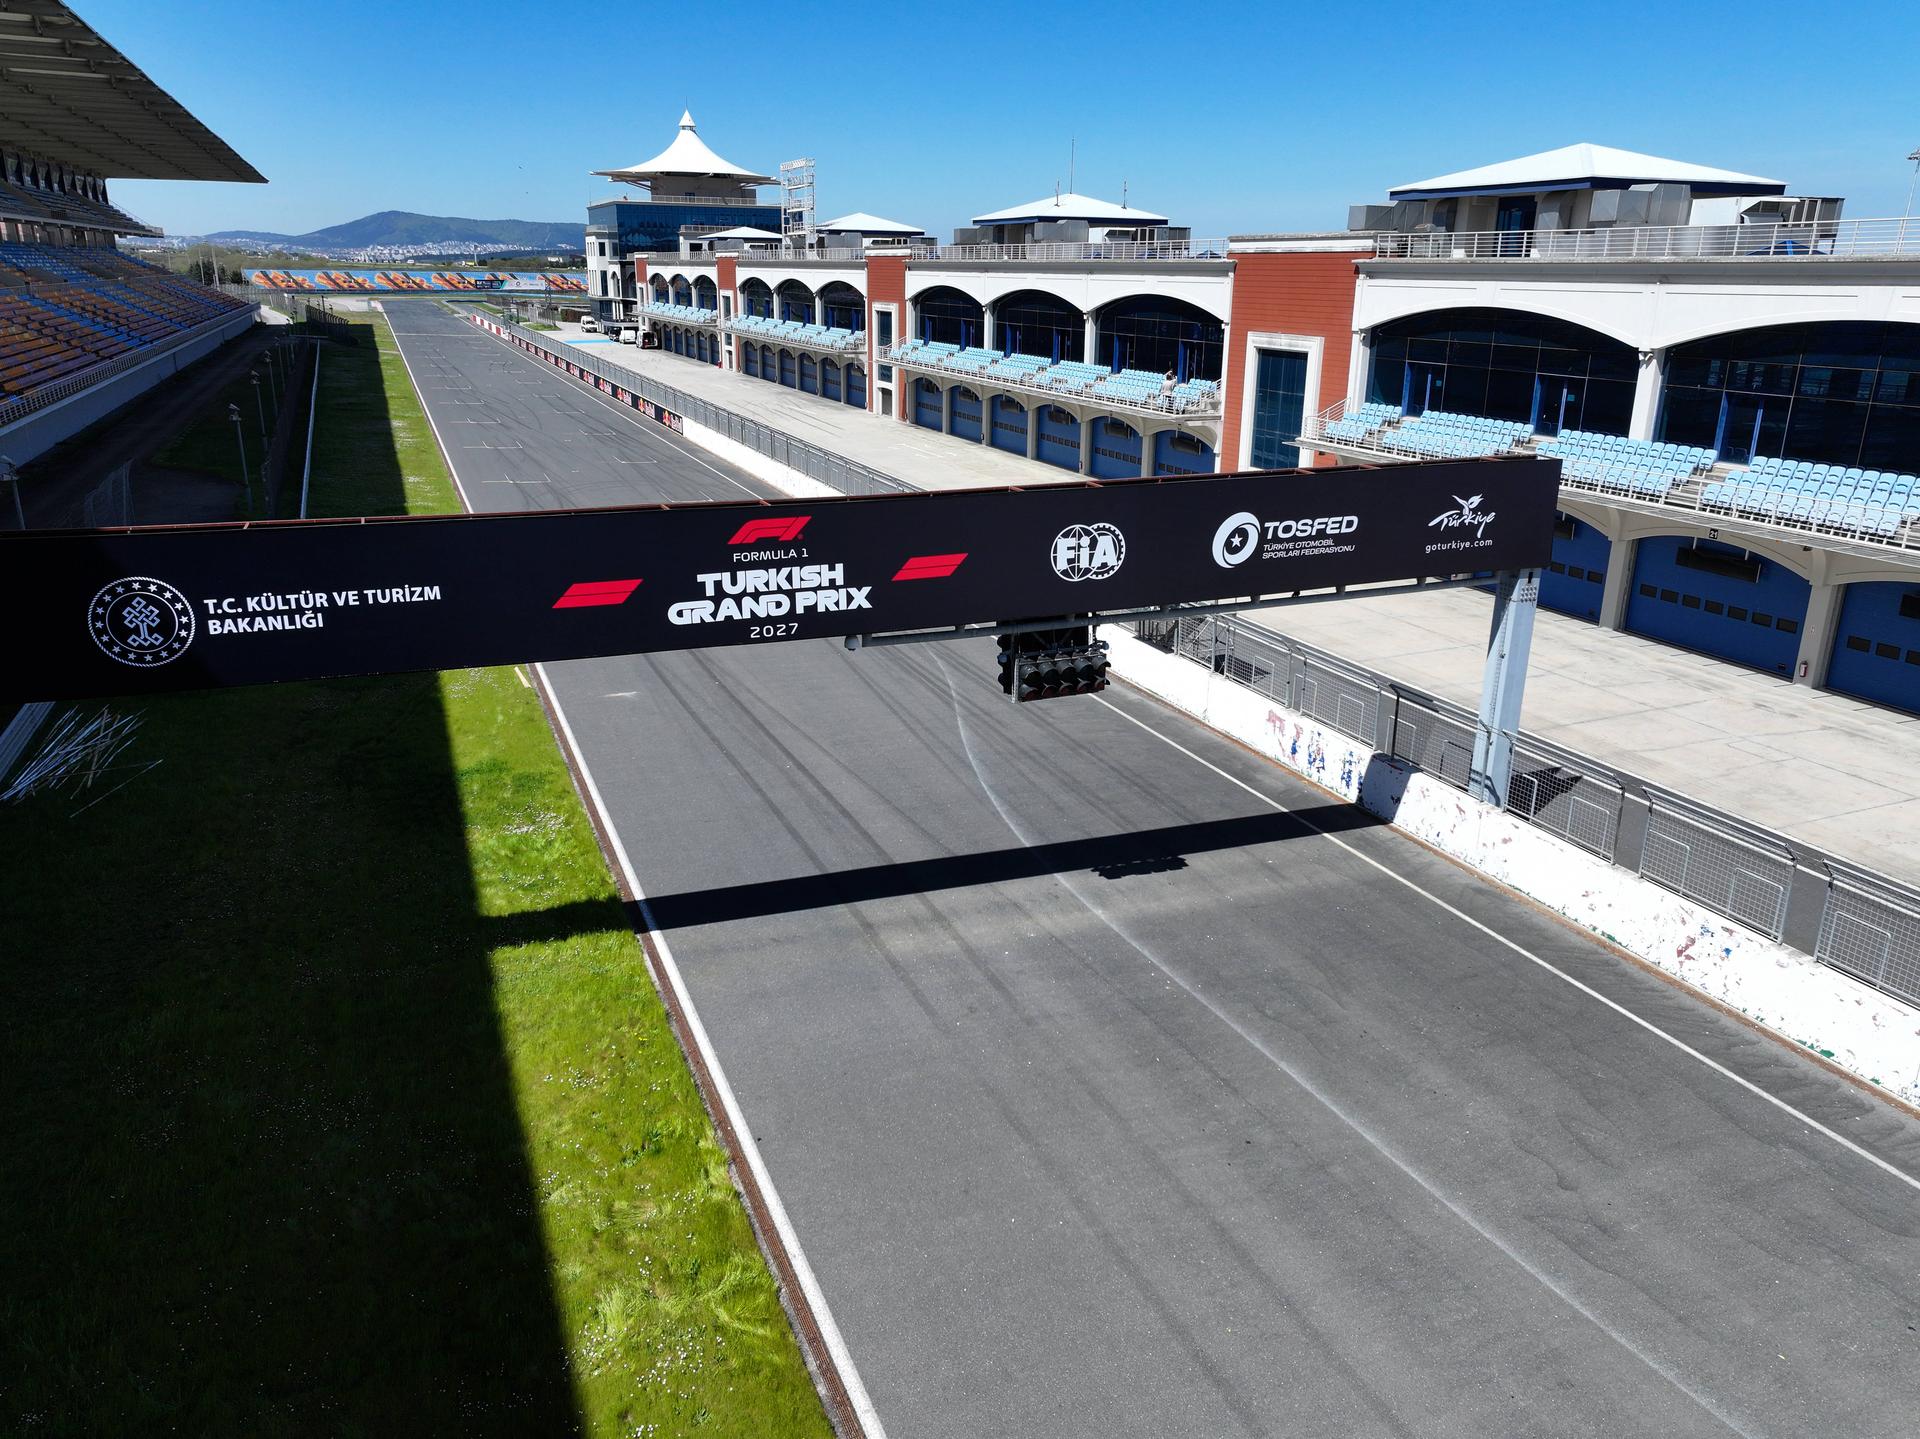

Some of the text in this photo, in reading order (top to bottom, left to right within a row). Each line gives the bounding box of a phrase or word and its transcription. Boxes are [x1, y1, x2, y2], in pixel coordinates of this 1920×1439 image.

[1265, 516, 1358, 539] TOSFED
[734, 548, 809, 562] FORMULA 1
[1262, 545, 1356, 560] SPORLARI FEDERASYONU
[1426, 540, 1492, 553] goturkiye.com
[697, 563, 844, 596] TURKISH
[204, 585, 441, 614] T.C. KÜLTÜR VE TURİZM
[668, 586, 872, 625] GRAND PRIX
[208, 611, 323, 634] BAKANLIĞI
[751, 623, 798, 638] 2027
